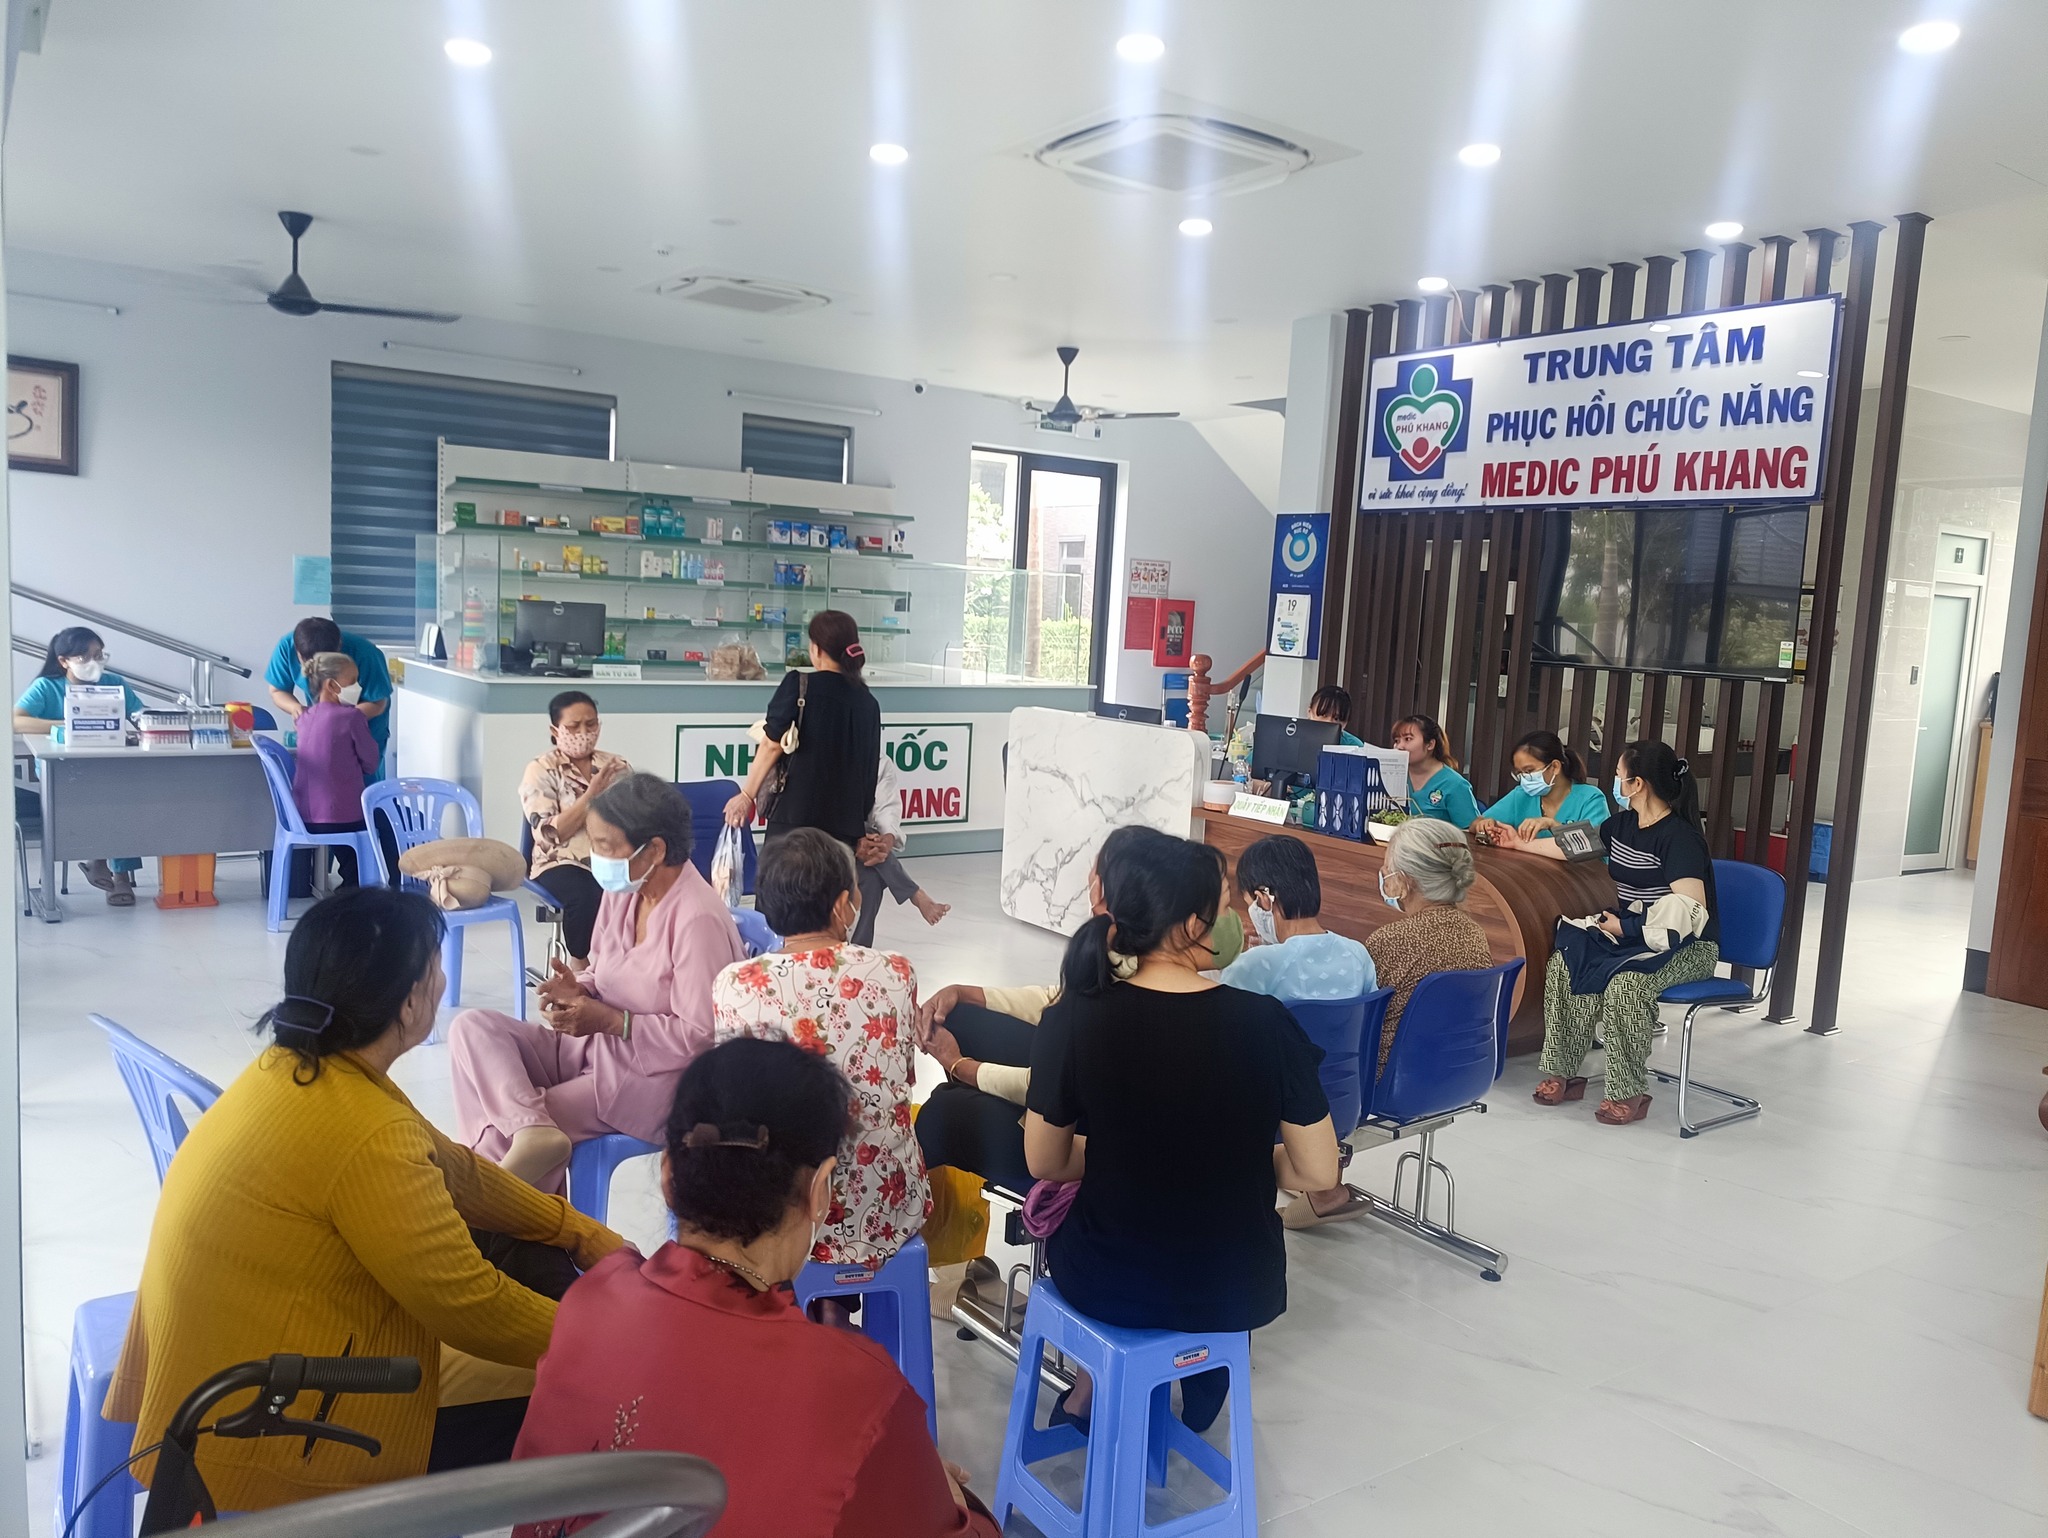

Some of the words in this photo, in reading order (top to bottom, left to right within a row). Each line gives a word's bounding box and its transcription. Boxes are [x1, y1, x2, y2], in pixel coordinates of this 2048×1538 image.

[1523, 338, 1653, 384] TRUNG
[1666, 321, 1766, 369] TÂM
[1397, 412, 1416, 421] medic
[1416, 421, 1449, 432] KHANG
[1486, 407, 1558, 447] PHỤC
[1565, 389, 1616, 438] HỒI
[1624, 386, 1710, 434] CHỨC
[1719, 382, 1814, 427] NĂNG
[1480, 457, 1580, 498] MEDIC
[1589, 442, 1661, 495] PHÚ
[1673, 445, 1809, 492] KHANG
[1287, 599, 1298, 612] 19
[705, 744, 760, 777] NH
